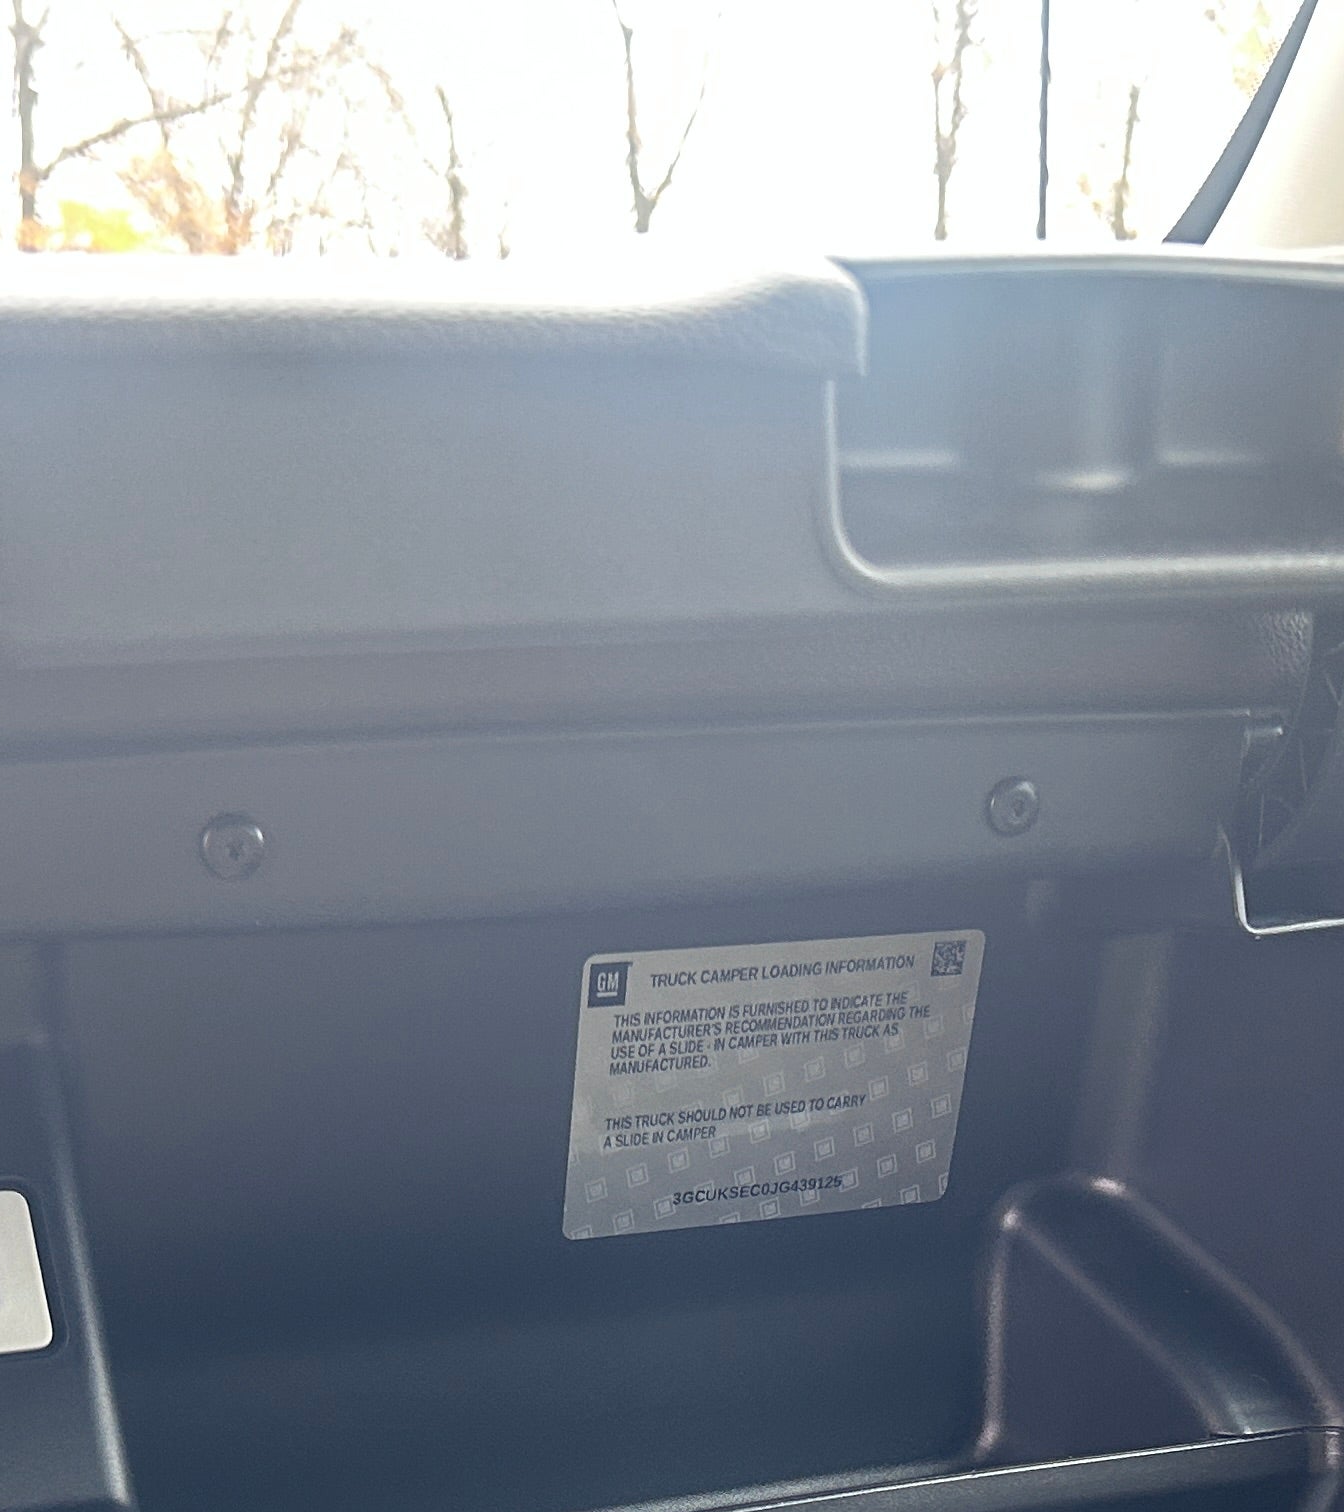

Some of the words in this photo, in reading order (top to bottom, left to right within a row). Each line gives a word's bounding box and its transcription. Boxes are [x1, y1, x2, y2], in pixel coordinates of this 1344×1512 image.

[597, 971, 619, 991] GM
[650, 971, 697, 988] TRUCK
[700, 966, 759, 984] CAMPER
[761, 961, 822, 980] LOADING
[825, 955, 915, 975] INFORMATION
[612, 1022, 722, 1044] MANUFACTURER'S
[725, 1013, 836, 1036] RECOMMENDATION
[838, 1006, 906, 1025] REGARDING
[909, 1004, 931, 1019] THE
[614, 1012, 641, 1028] THIS
[643, 1006, 726, 1026] INFORMATION
[728, 1004, 740, 1019] IS
[742, 999, 810, 1018] FURNISHED
[813, 998, 829, 1012] TO
[830, 993, 883, 1011] INDICATE
[886, 991, 907, 1006] THE
[610, 1045, 635, 1060] USE
[638, 1042, 655, 1058] OF
[658, 1042, 666, 1056] A
[669, 1039, 704, 1055] SLIDE
[714, 1037, 726, 1051] IN
[728, 1032, 778, 1050] CAMPER
[781, 1031, 811, 1046] WITH
[814, 1027, 839, 1043] THIS
[842, 1024, 880, 1040] TRUCK
[883, 1022, 899, 1036] AS
[609, 1054, 711, 1076] MANUFACTURED.
[604, 1115, 632, 1131] THIS
[634, 1112, 675, 1131] TRUCK
[678, 1107, 727, 1125] SHOULD
[729, 1104, 754, 1120] NOT
[756, 1103, 771, 1117] BE
[774, 1100, 806, 1117] USED
[809, 1097, 825, 1112] TO
[826, 1094, 867, 1110] CARRY
[603, 1135, 612, 1149] A
[614, 1131, 650, 1148] SLIDE
[652, 1130, 664, 1144] IN
[666, 1125, 716, 1143] CAMPER
